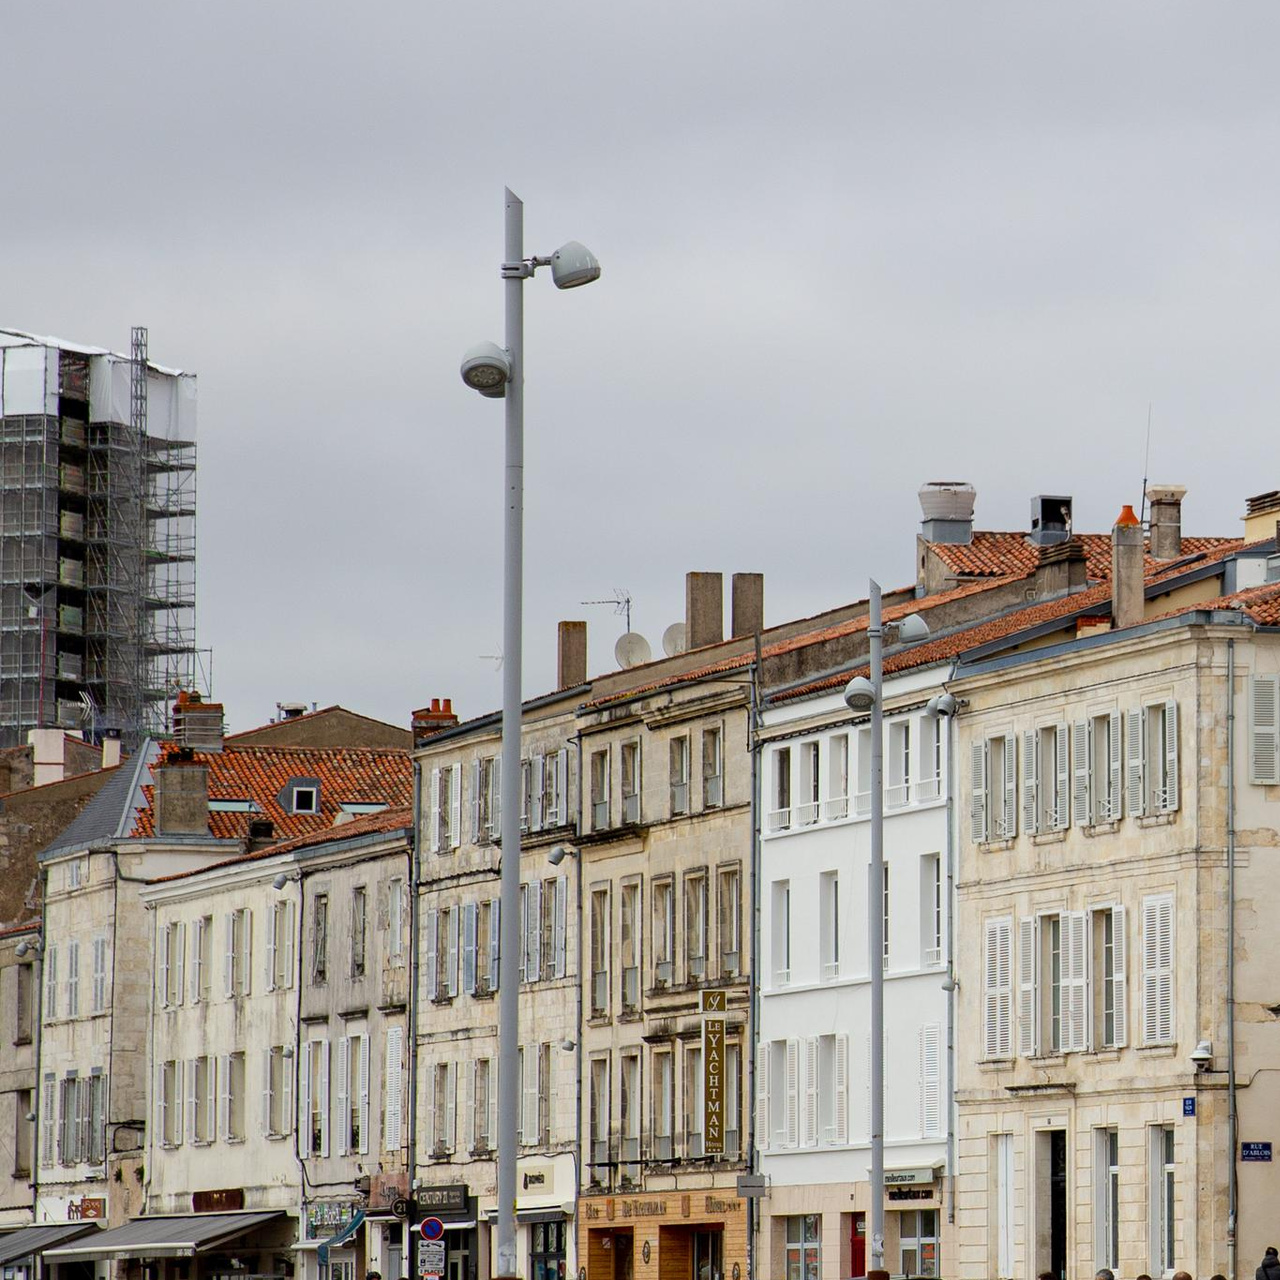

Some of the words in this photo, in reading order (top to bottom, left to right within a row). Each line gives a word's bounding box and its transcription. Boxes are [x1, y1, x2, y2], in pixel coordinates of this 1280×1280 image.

[707, 1033, 720, 1139] YACHTMAN
[419, 1192, 442, 1205] CENTURY
[397, 1202, 406, 1212] 21
